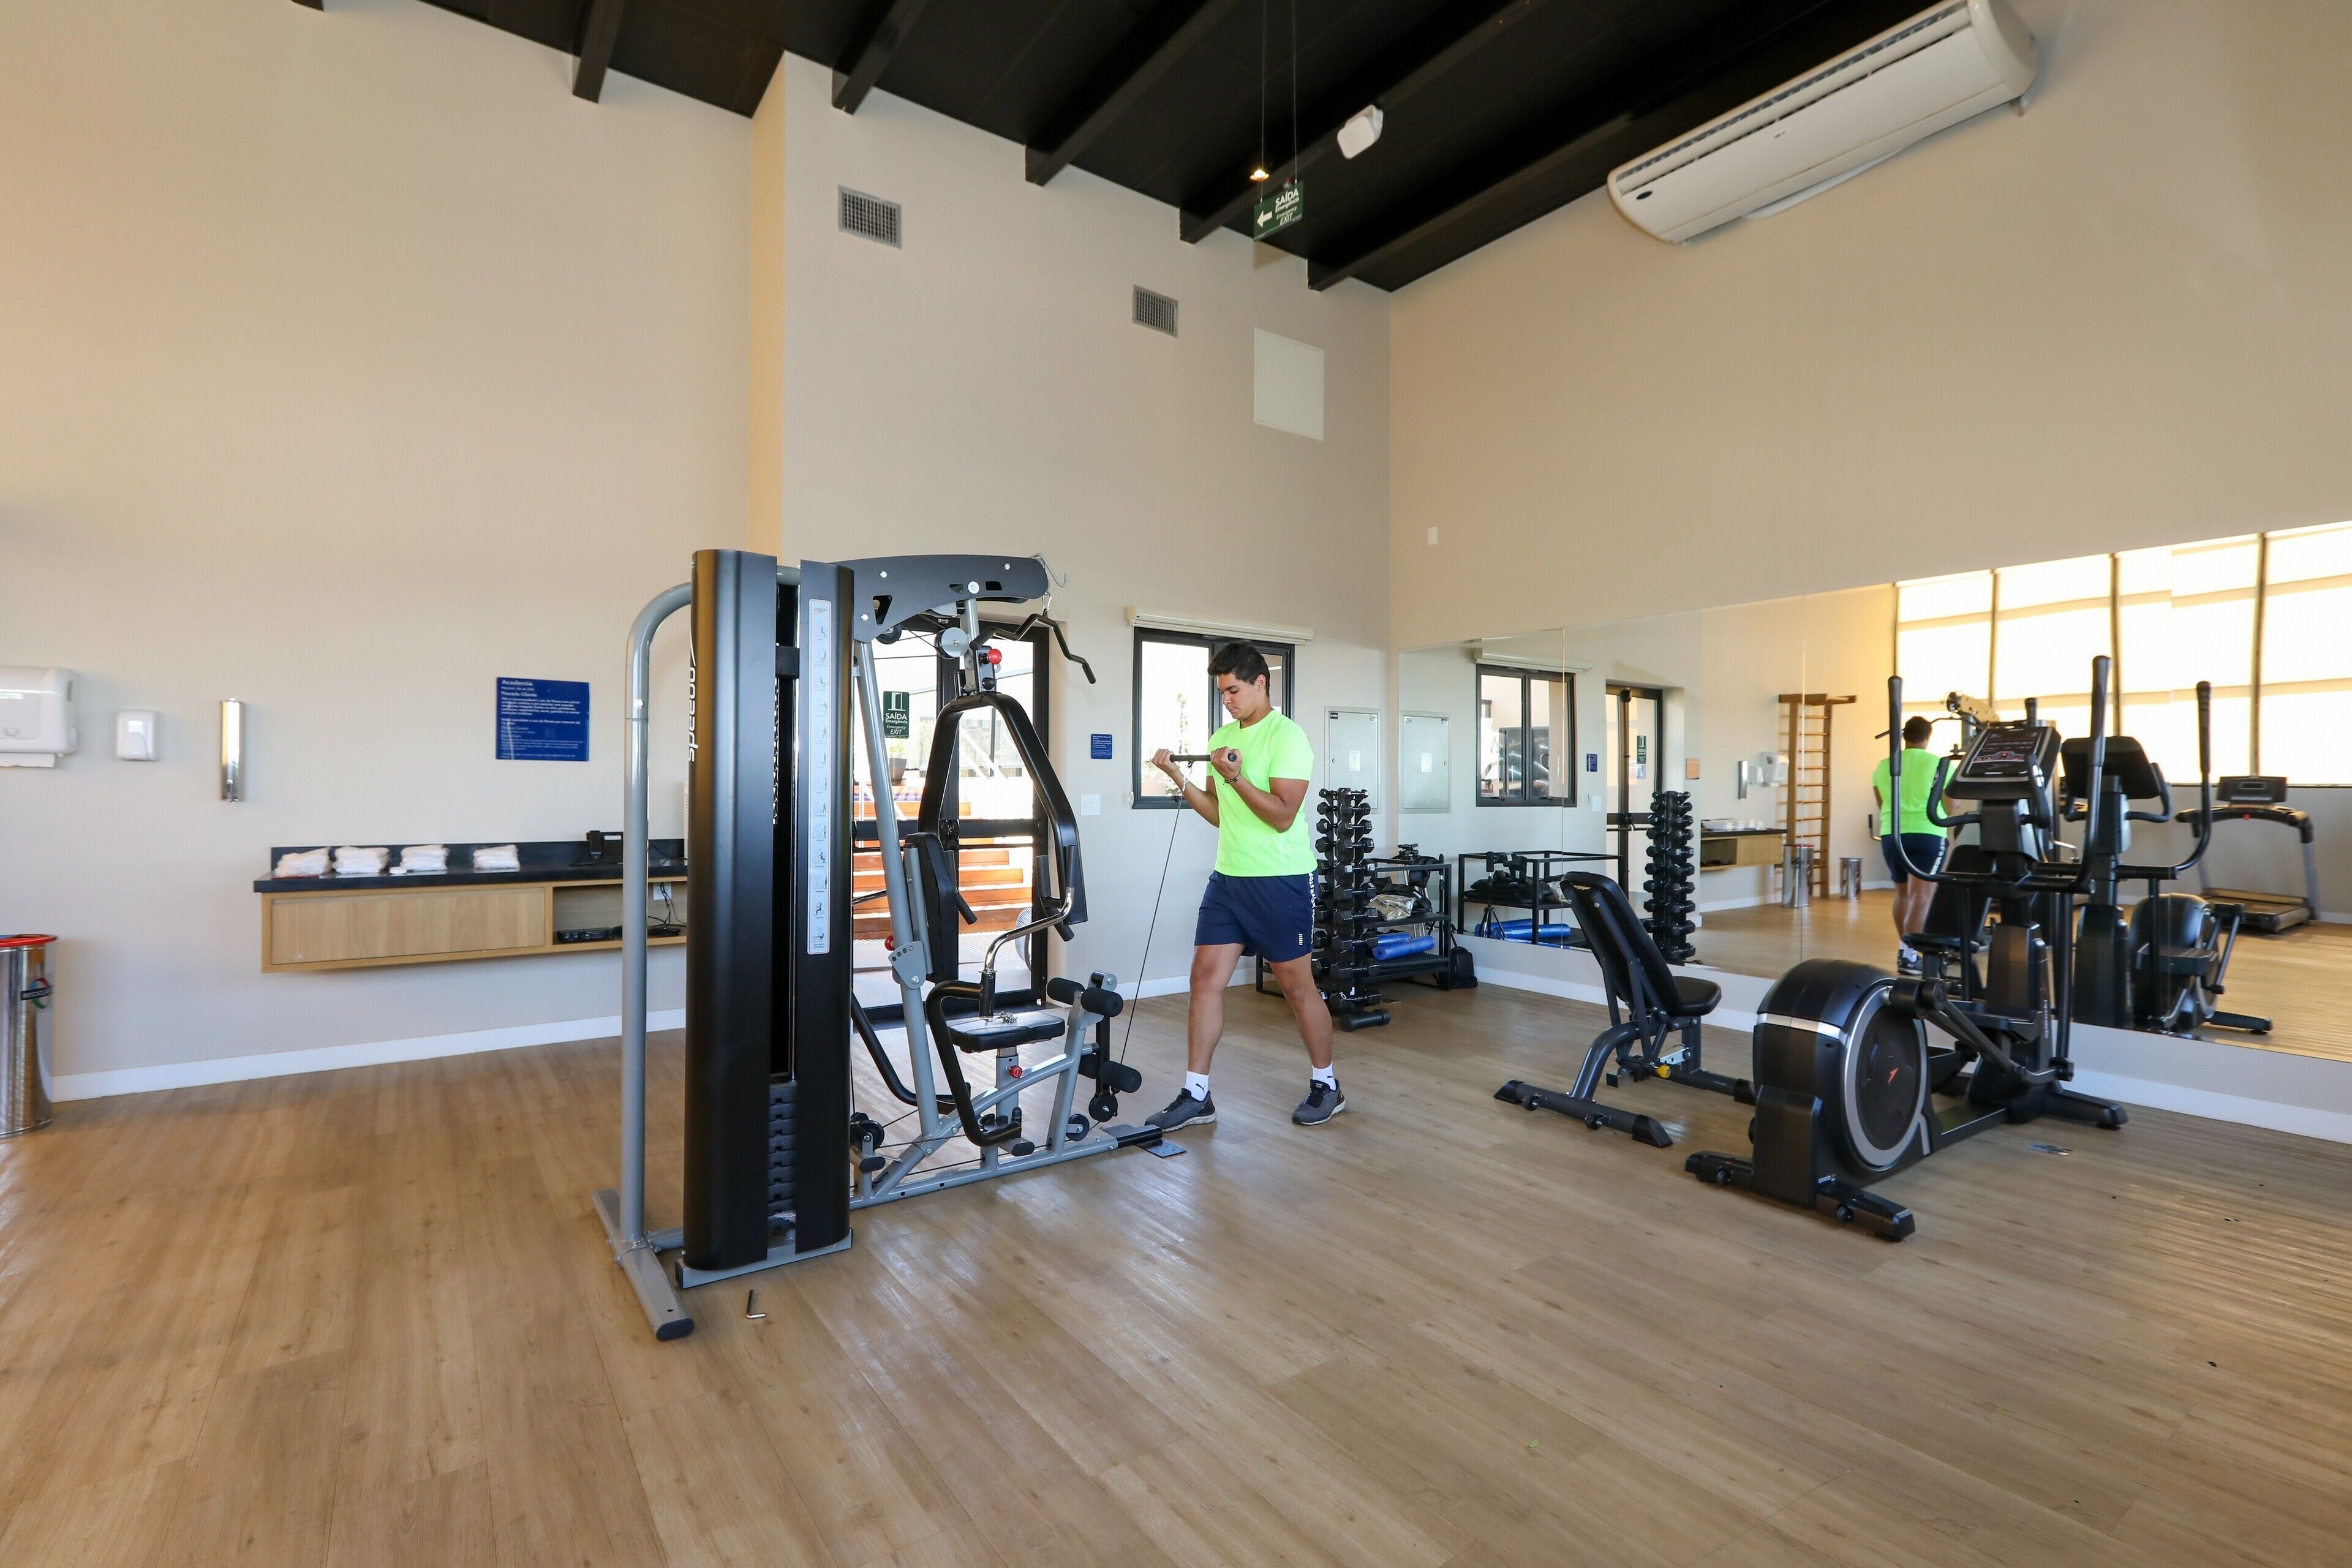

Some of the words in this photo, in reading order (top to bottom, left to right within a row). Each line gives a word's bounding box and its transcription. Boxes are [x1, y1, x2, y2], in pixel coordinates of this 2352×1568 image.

[1275, 188, 1298, 206] SAÍDA
[1280, 212, 1294, 225] EXIT
[885, 712, 907, 720] SAÍDA
